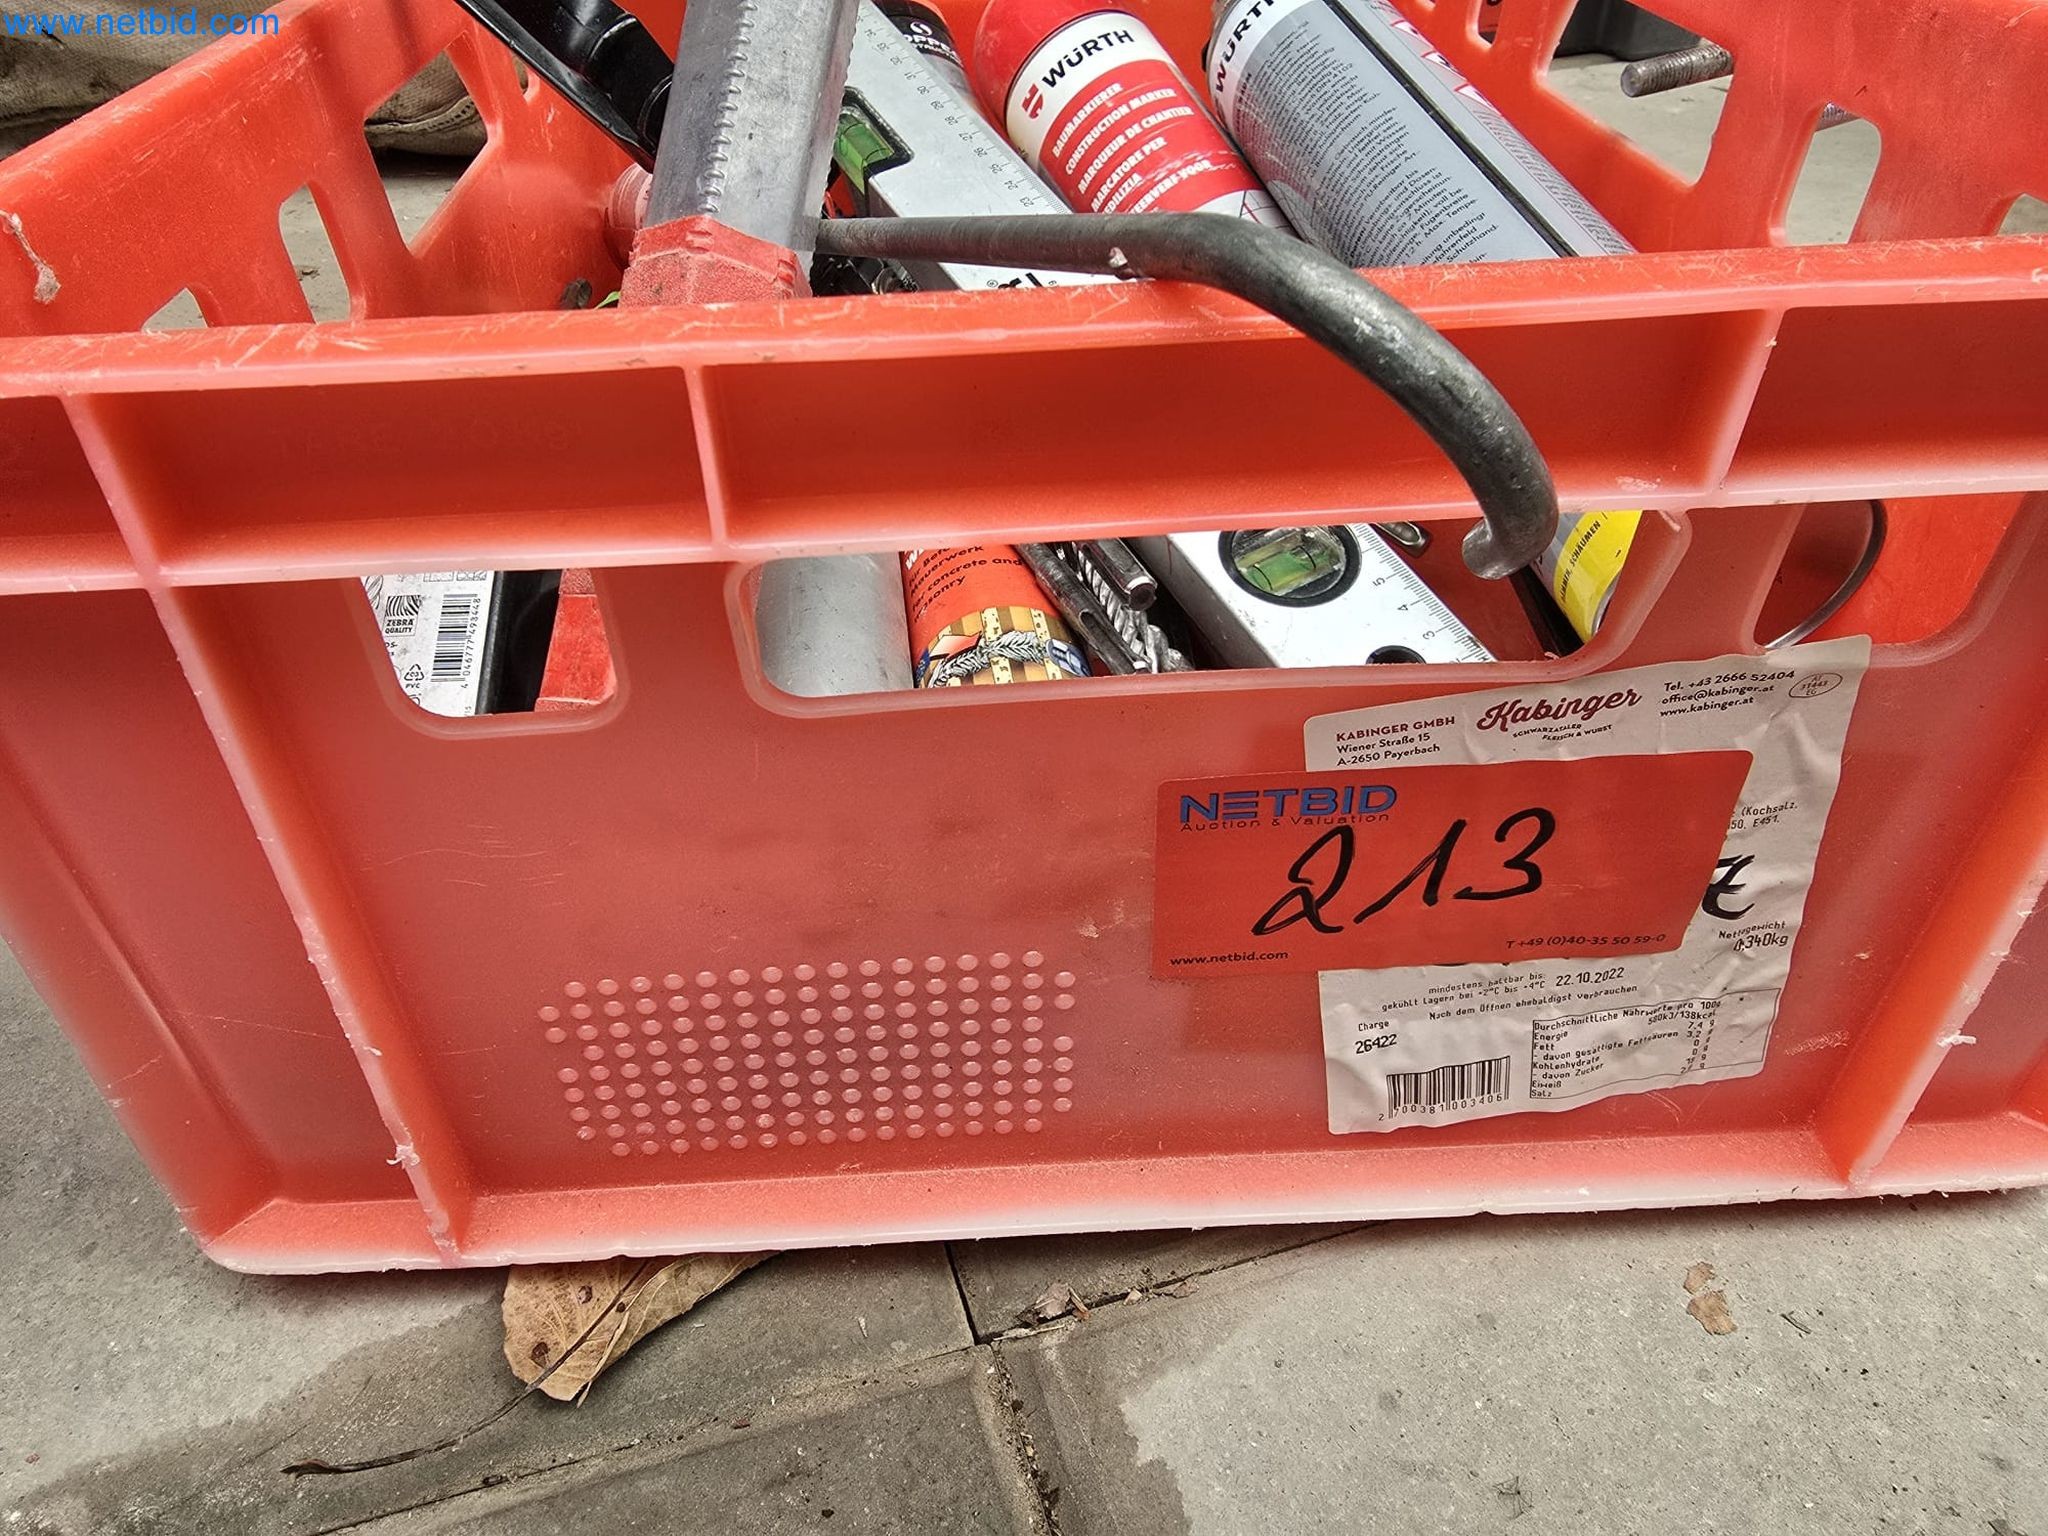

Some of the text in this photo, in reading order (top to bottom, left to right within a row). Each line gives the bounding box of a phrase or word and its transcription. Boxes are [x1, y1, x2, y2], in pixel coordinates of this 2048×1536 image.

[1042, 29, 1134, 88] WÜRTH
[1052, 83, 1123, 158] BAUMARKIERER
[1065, 88, 1177, 175] CONSTRUCTION MARKER
[1077, 106, 1195, 194] MARQUEUR DE CHANTIER
[1090, 136, 1168, 212] MARCATORE PER
[1404, 168, 1419, 180] bis
[1431, 170, 1443, 180] ist
[1392, 185, 1409, 201] und
[1412, 186, 1448, 214] Minuten
[1431, 194, 1449, 208] voll
[1418, 191, 1469, 230] Fugenbreite
[1422, 217, 1447, 237] Max.
[1441, 210, 1486, 244] unbedingt
[1570, 520, 1601, 567] SCHÄUMEN
[910, 545, 984, 597] Mauerwerk
[927, 558, 988, 591] concrete
[1372, 576, 1386, 588] 5
[469, 597, 482, 637] 493448
[1397, 603, 1409, 612] 4
[385, 627, 412, 635] QUALITY
[387, 618, 414, 627] ZEBRA
[1423, 630, 1436, 640] 3
[464, 639, 475, 677] 046777
[1664, 670, 1795, 692] Tel. +43 2666 52404
[1661, 685, 1774, 705] office@kabinger.at
[1476, 688, 1642, 732] Kabinger
[1660, 697, 1754, 717] www.kabinger.at
[1336, 716, 1455, 743] KABINGER GMBH
[1584, 724, 1613, 735] WURST
[1337, 732, 1431, 754] Wiener Straße 15
[1337, 744, 1440, 766] A-2650 Payerbach
[1180, 784, 1397, 823] NETBID
[1180, 814, 1389, 833] Auction & Valuation
[1251, 807, 1556, 936] 213
[1718, 920, 1787, 939] Nettogewicht
[1506, 933, 1667, 949] T +49 (0)40-35 50 59-0
[1170, 950, 1289, 966] www.netbid.com
[1555, 966, 1625, 987] 22.10.2022
[1428, 980, 1483, 994] mindestens
[1504, 985, 1519, 993] bis
[1429, 984, 1638, 1021] Nach dem Öffnen ehebaldigst verbrauchen
[1358, 1020, 1390, 1032] Charge
[1534, 1012, 1619, 1031] Durchschnittliche
[1677, 1001, 1694, 1010] pro
[1354, 1034, 1398, 1055] 26422
[1534, 1030, 1568, 1042] Energie
[1534, 1042, 1555, 1051] Fett
[1543, 1051, 1571, 1061] davon
[1532, 1055, 1600, 1071] Kohlenhydrate
[1542, 1070, 1571, 1080] davon
[1574, 1062, 1605, 1077] Zucker
[1531, 1079, 1562, 1089] Eiweiß
[1378, 1094, 1503, 1122] 2 700381 003406
